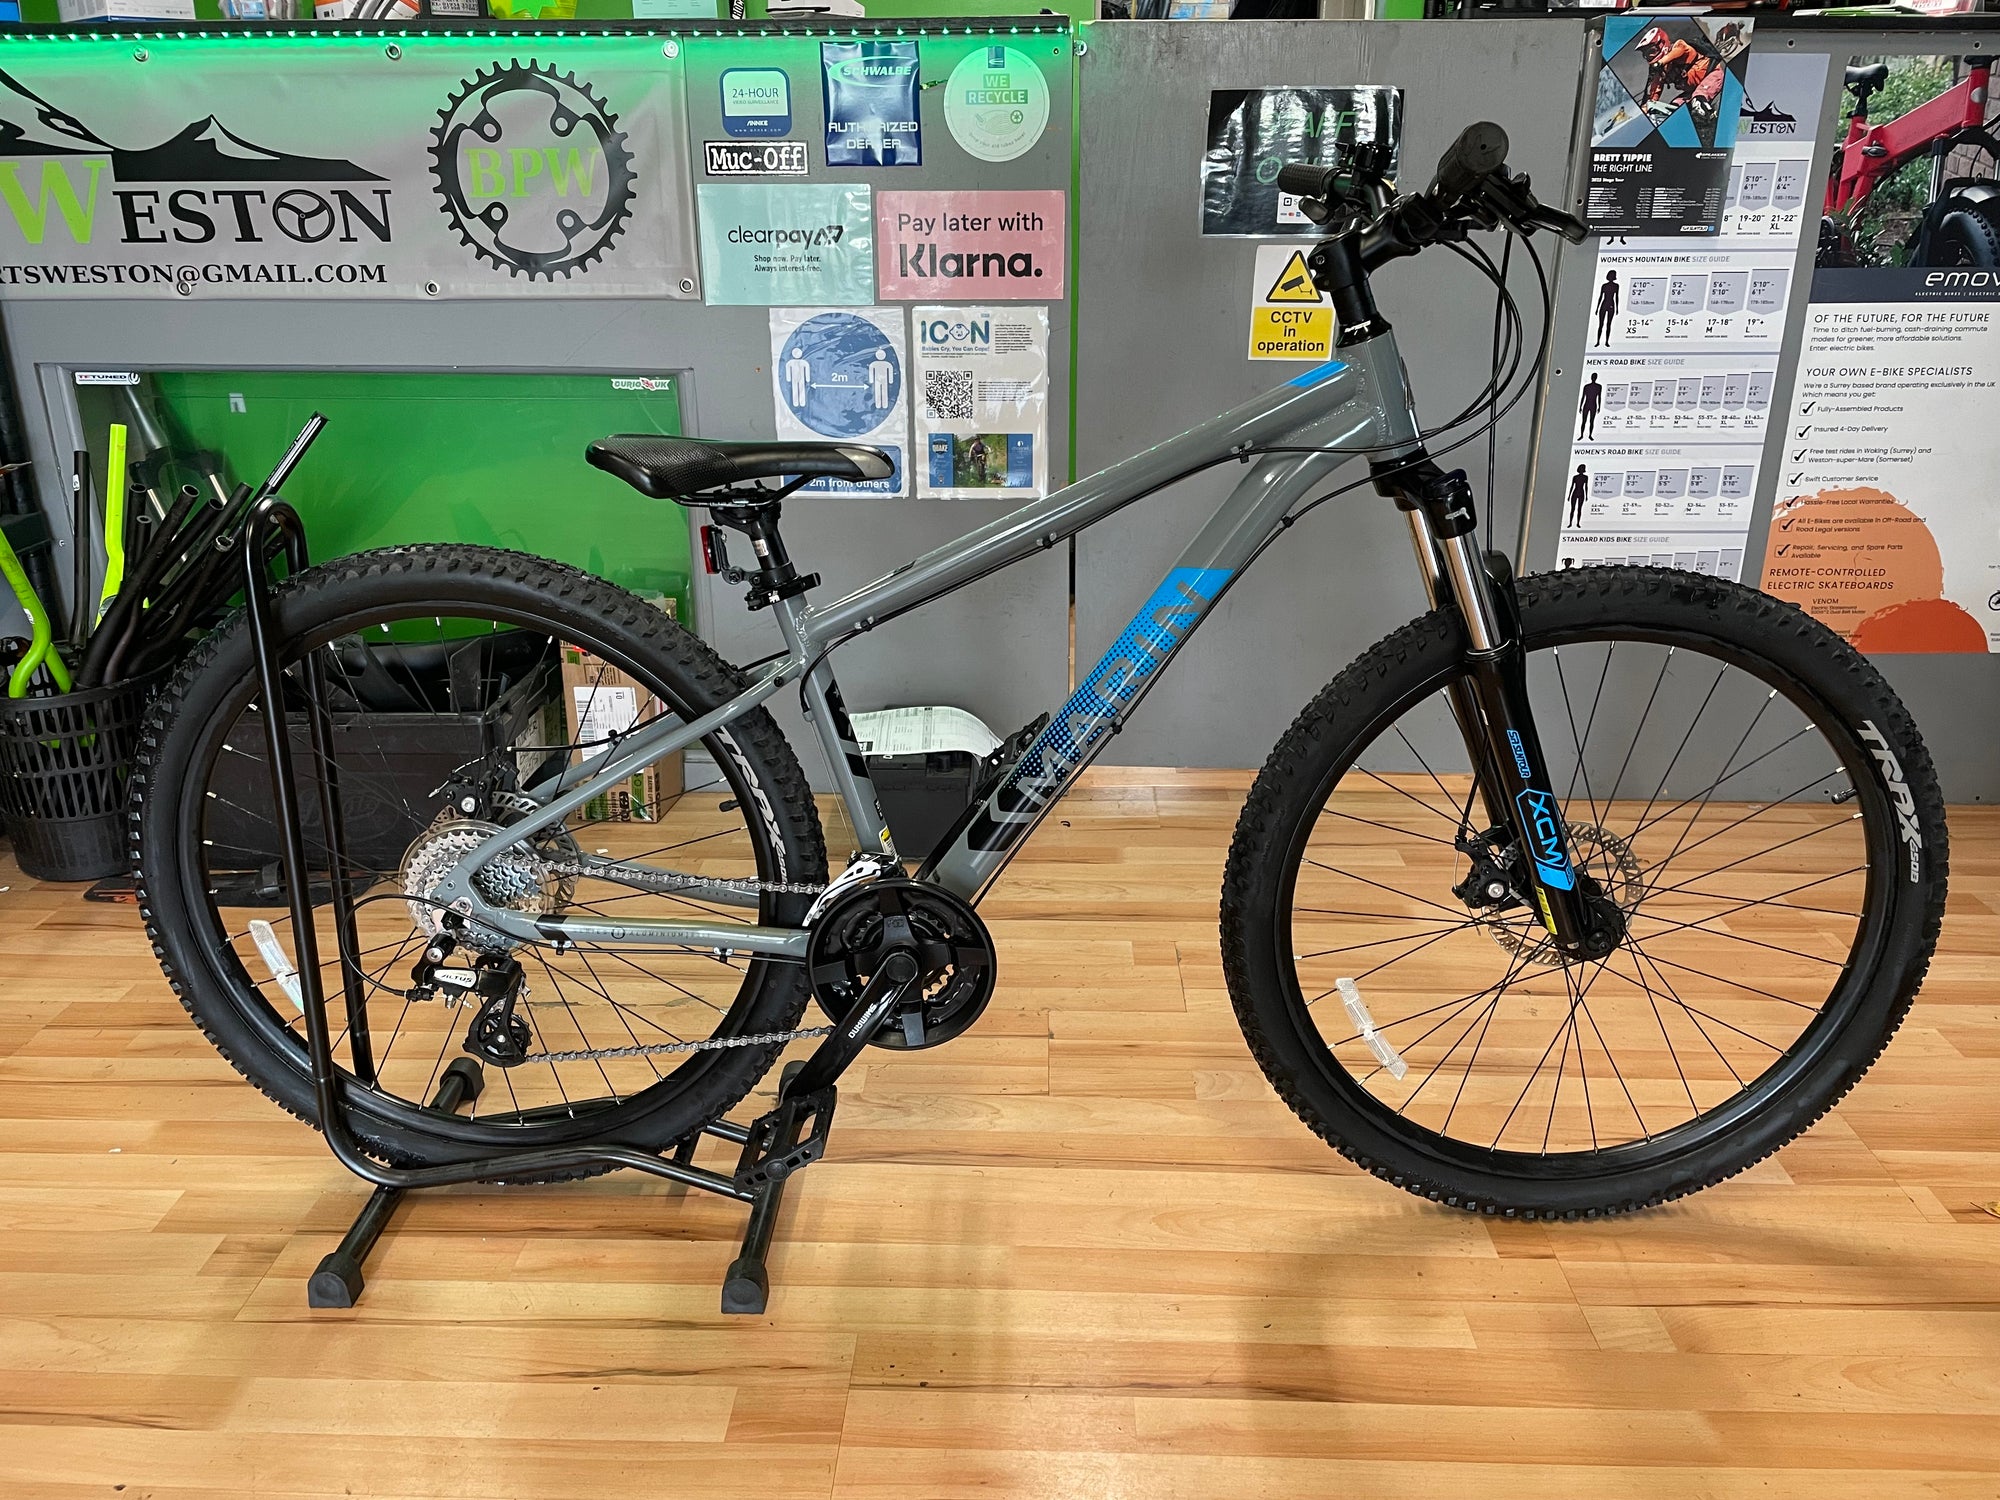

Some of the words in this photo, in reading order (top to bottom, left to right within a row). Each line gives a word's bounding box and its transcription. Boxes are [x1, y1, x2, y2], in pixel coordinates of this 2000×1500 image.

[844, 66, 912, 76] SCHWALBE
[985, 76, 1008, 87] WE
[732, 88, 779, 98] 24-HOUR
[968, 91, 1025, 103] RECYCLE
[847, 139, 901, 149] DEAER
[711, 147, 802, 170] Muc-Off
[1594, 154, 1622, 162] BRETT
[1623, 154, 1652, 162] TIPPIE
[464, 146, 599, 198] BPW
[1593, 164, 1608, 172] THE
[1609, 164, 1634, 172] RIGHT
[1635, 164, 1653, 172] LINE
[898, 213, 936, 236] Pay
[944, 213, 992, 232] later
[998, 212, 1044, 232] with
[728, 225, 813, 250] clearpay
[754, 254, 771, 263] Shop
[790, 254, 803, 264] Pay
[804, 254, 822, 262] later.
[900, 244, 1043, 278] Klarna.
[754, 264, 777, 273] Always
[778, 264, 822, 273] interest-free.
[0, 263, 387, 285] TSWESTON@GMAIL.COM
[1270, 312, 1313, 324] CCTV
[1814, 315, 1830, 323] OF
[1834, 314, 1852, 323] THE
[1856, 314, 1898, 323] FUTURE,
[1901, 314, 1922, 322] FOR
[1927, 314, 1946, 322] THE
[1950, 314, 1990, 322] FUTURE
[1283, 326, 1296, 337] in
[1257, 340, 1325, 355] operation
[1806, 368, 1836, 377] YOUR
[1839, 368, 1867, 376] OWN
[1870, 368, 1905, 377] E-BIKE
[1908, 367, 1973, 376] SPECIALISTS
[831, 372, 849, 383] 2m
[1830, 382, 1851, 390] Surrey
[1897, 382, 1929, 390] operating
[1931, 381, 1966, 389] exclusively
[1890, 447, 1917, 455] (Surrey)
[1876, 456, 1914, 464] (Somerset)
[810, 479, 825, 487] 2m
[829, 478, 853, 487] from
[856, 480, 890, 488] others
[1769, 568, 1886, 577] REMOTE-CONTROLLED
[1767, 582, 1815, 590] ELECTRIC
[1818, 581, 1894, 589] SKATEBOARDS
[1016, 581, 1210, 805] MARIN
[1528, 795, 1565, 864] XCM
[848, 1003, 877, 1039] SHIMANO
